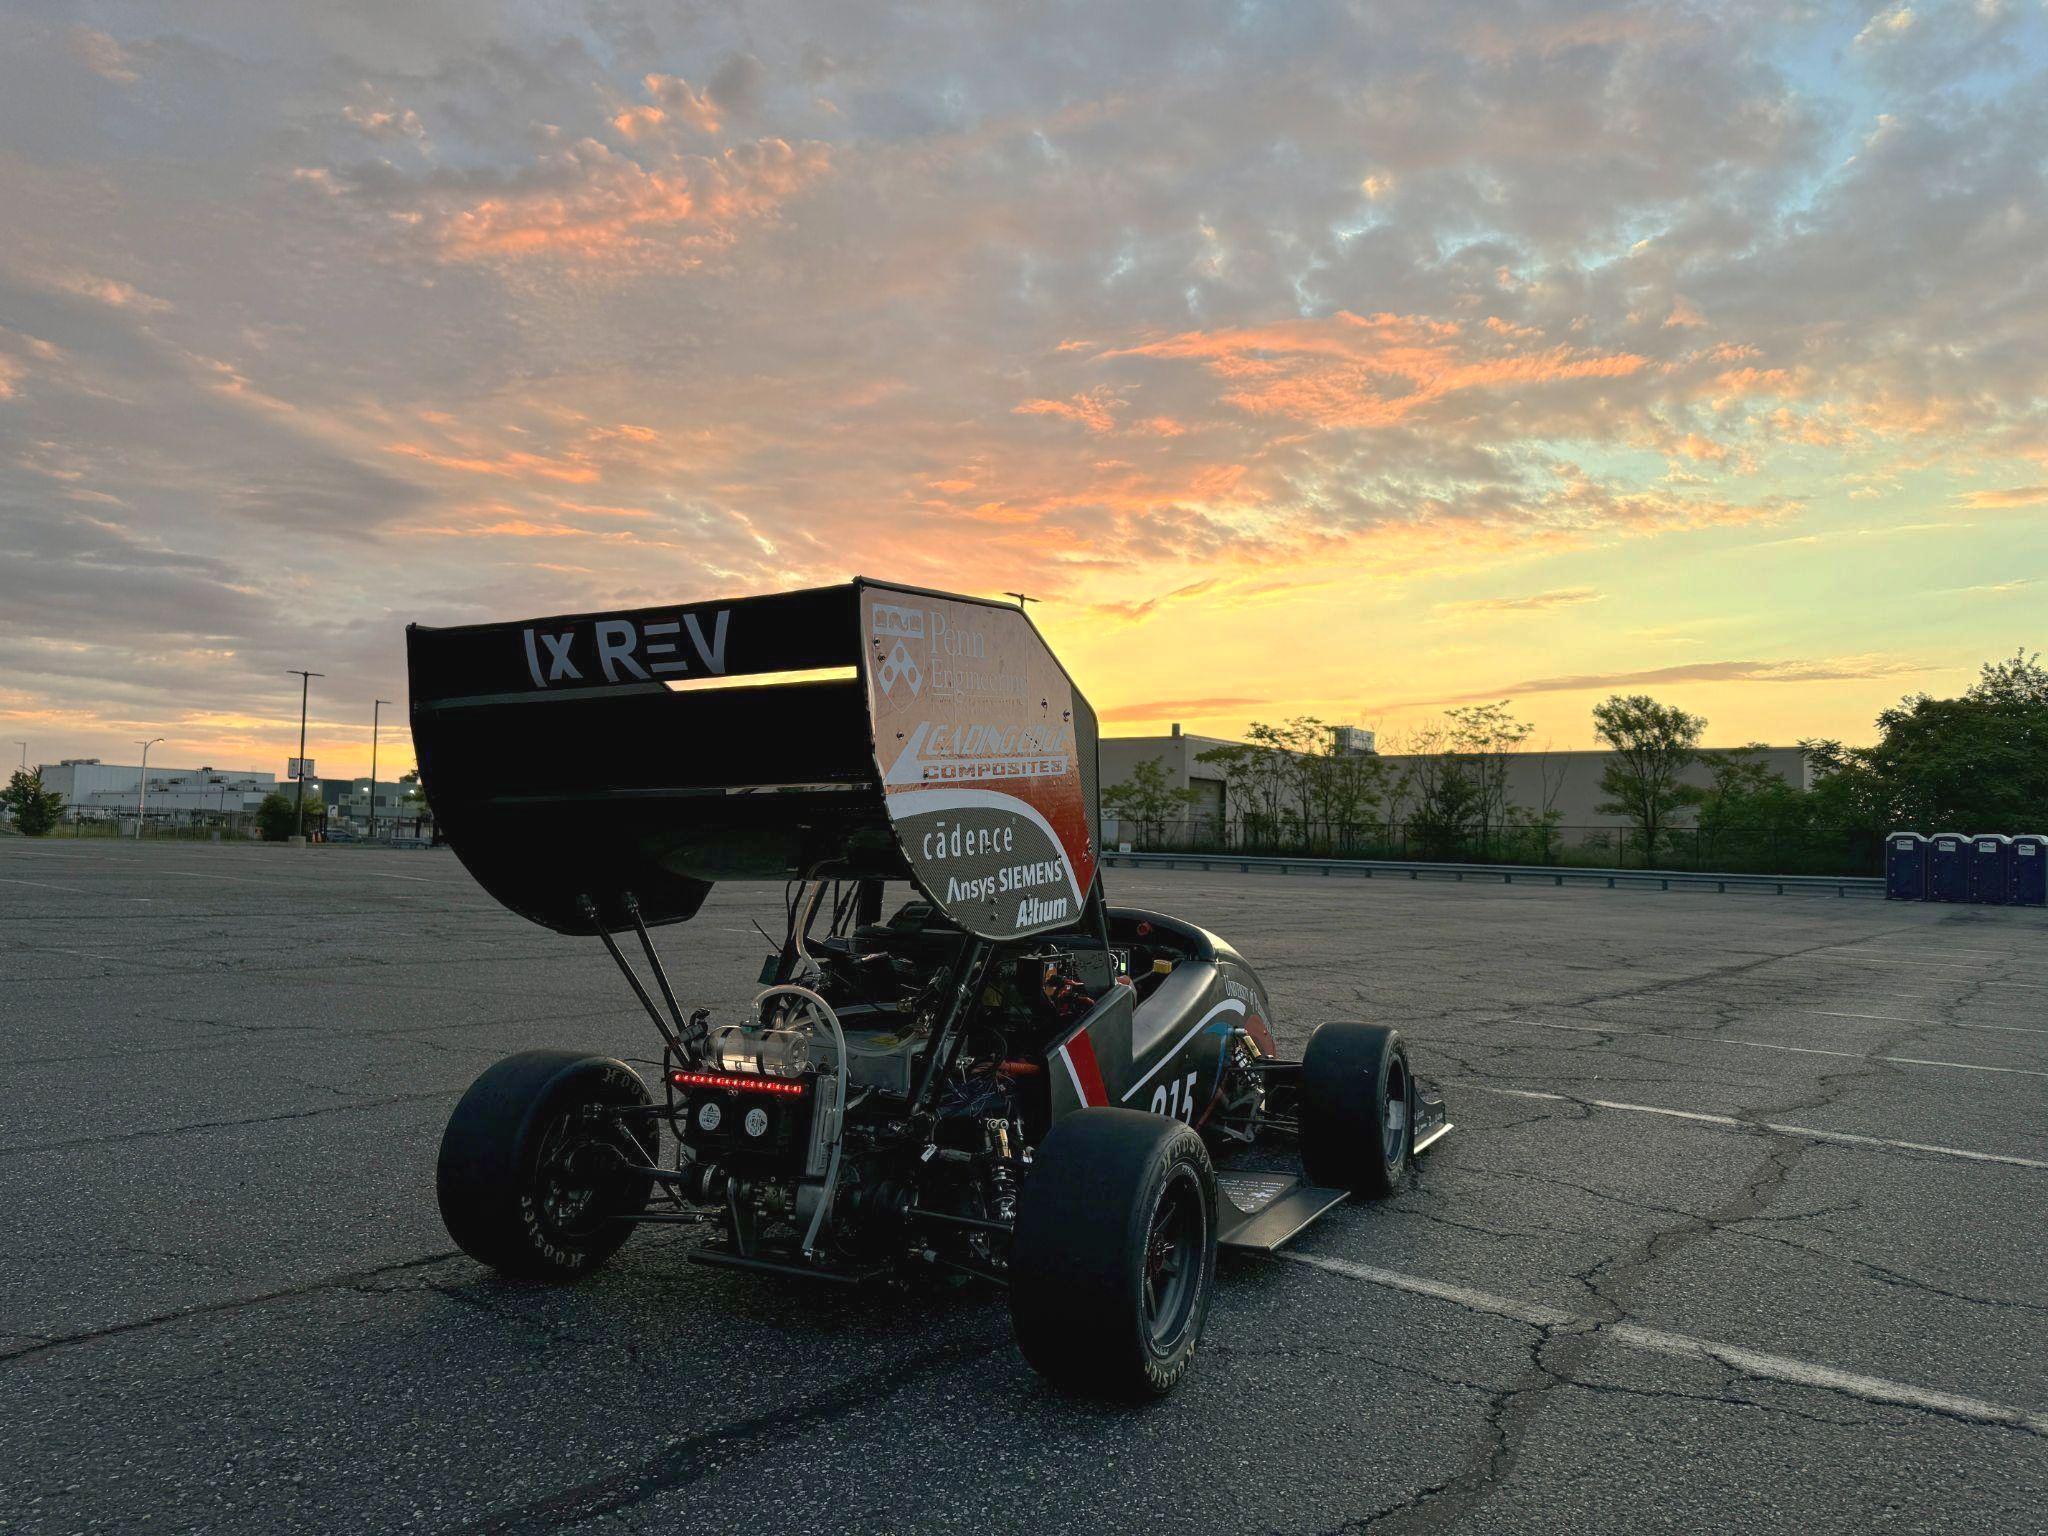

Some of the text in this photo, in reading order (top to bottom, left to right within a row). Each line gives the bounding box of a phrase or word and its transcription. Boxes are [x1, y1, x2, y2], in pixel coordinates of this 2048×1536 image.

[594, 610, 730, 683] REV
[930, 611, 986, 659] Penn
[925, 760, 1063, 780] COMPOSITES
[946, 860, 1063, 903] Ansys SIEMENS
[1015, 897, 1068, 928] Altium
